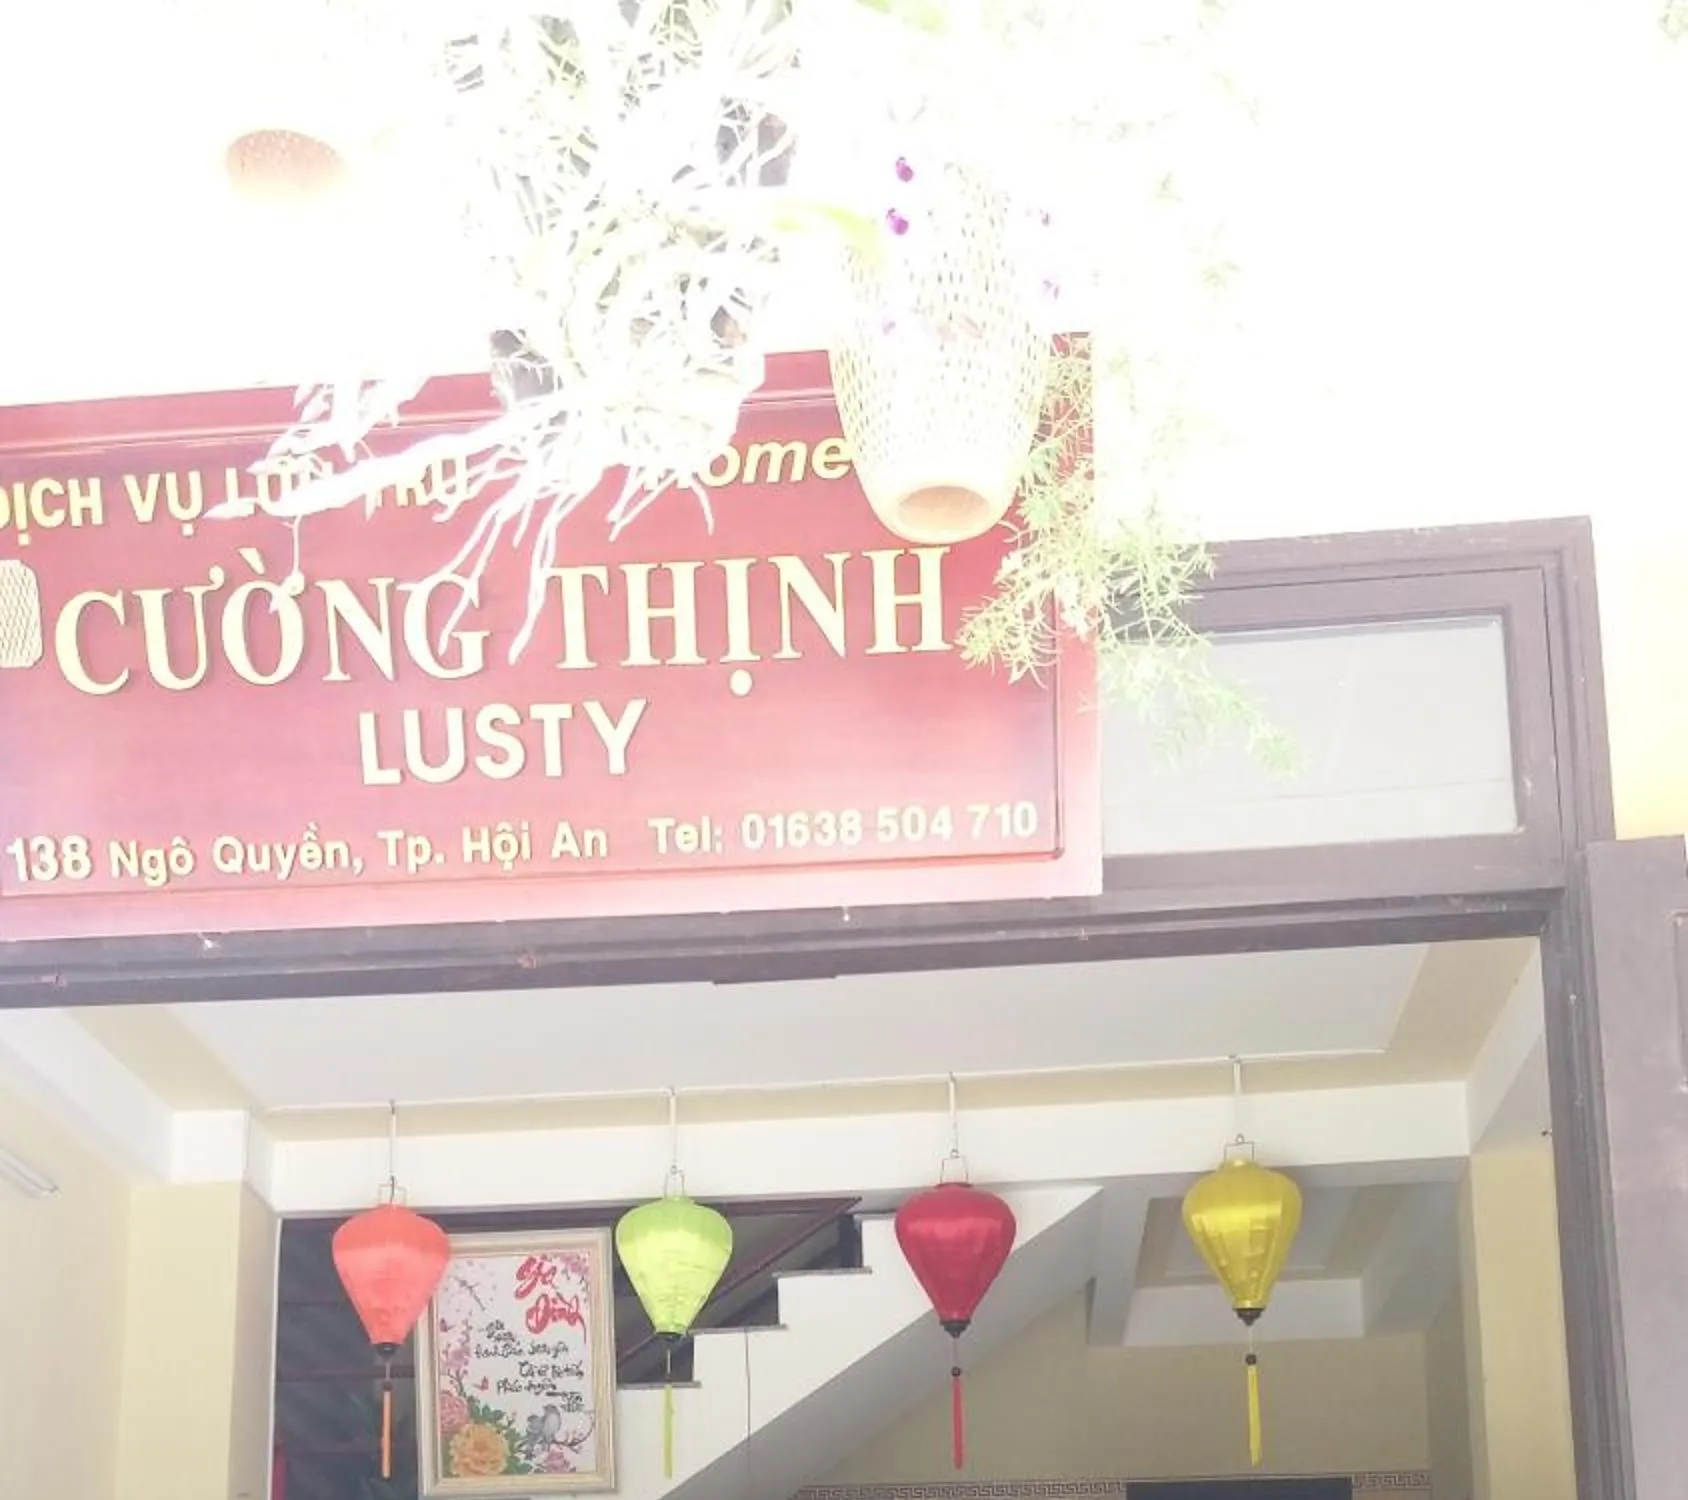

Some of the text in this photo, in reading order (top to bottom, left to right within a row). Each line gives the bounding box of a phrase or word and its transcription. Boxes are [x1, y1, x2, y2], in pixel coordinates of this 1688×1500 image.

[123, 469, 204, 537] VỤ
[54, 545, 957, 697] CƯỜNG THỊNH
[359, 698, 648, 786] LUSTY
[7, 801, 1039, 887] 138 Ngô Quyền, Tp. Hội An Tel: 01638 504 710
